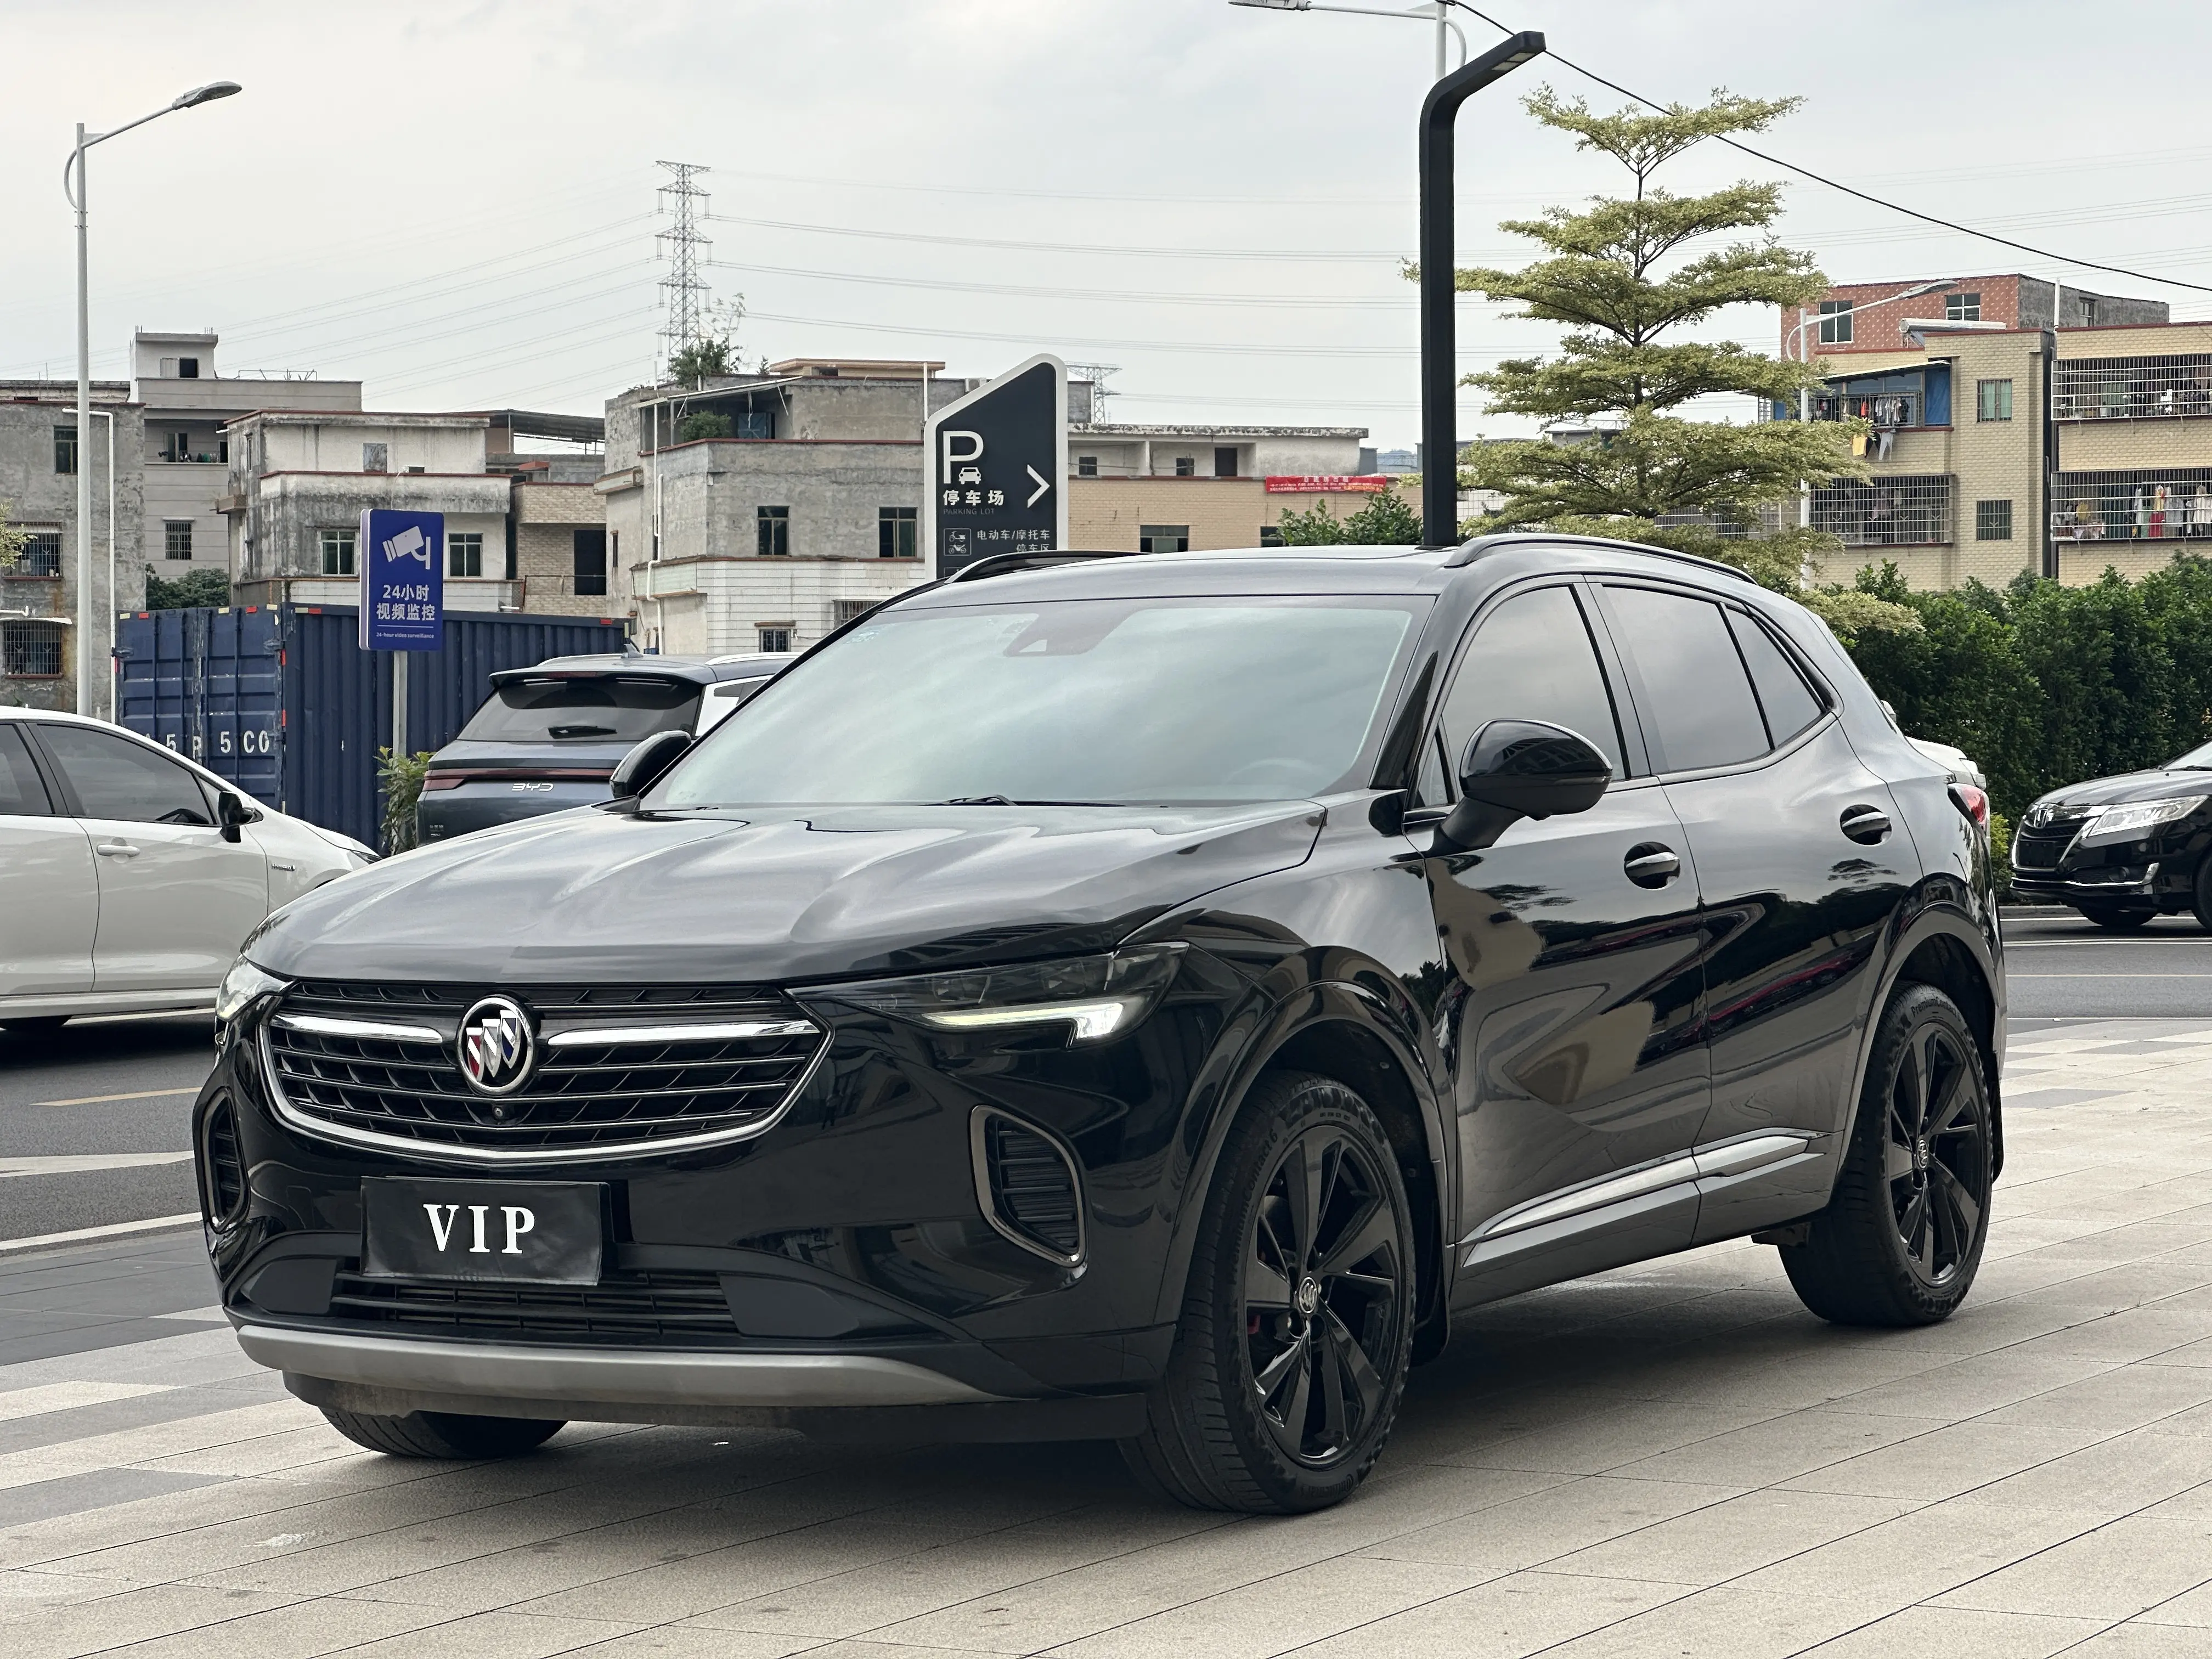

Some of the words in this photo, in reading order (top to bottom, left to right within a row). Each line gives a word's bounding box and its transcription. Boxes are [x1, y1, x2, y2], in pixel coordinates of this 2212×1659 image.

[943, 430, 984, 484] P
[943, 489, 1004, 506] 停车场
[977, 529, 1050, 540] 电动车/摩托车
[383, 584, 429, 602] 24小时
[376, 602, 435, 621] 视频监控
[511, 783, 554, 792] BYD
[423, 1203, 536, 1255] VIP
